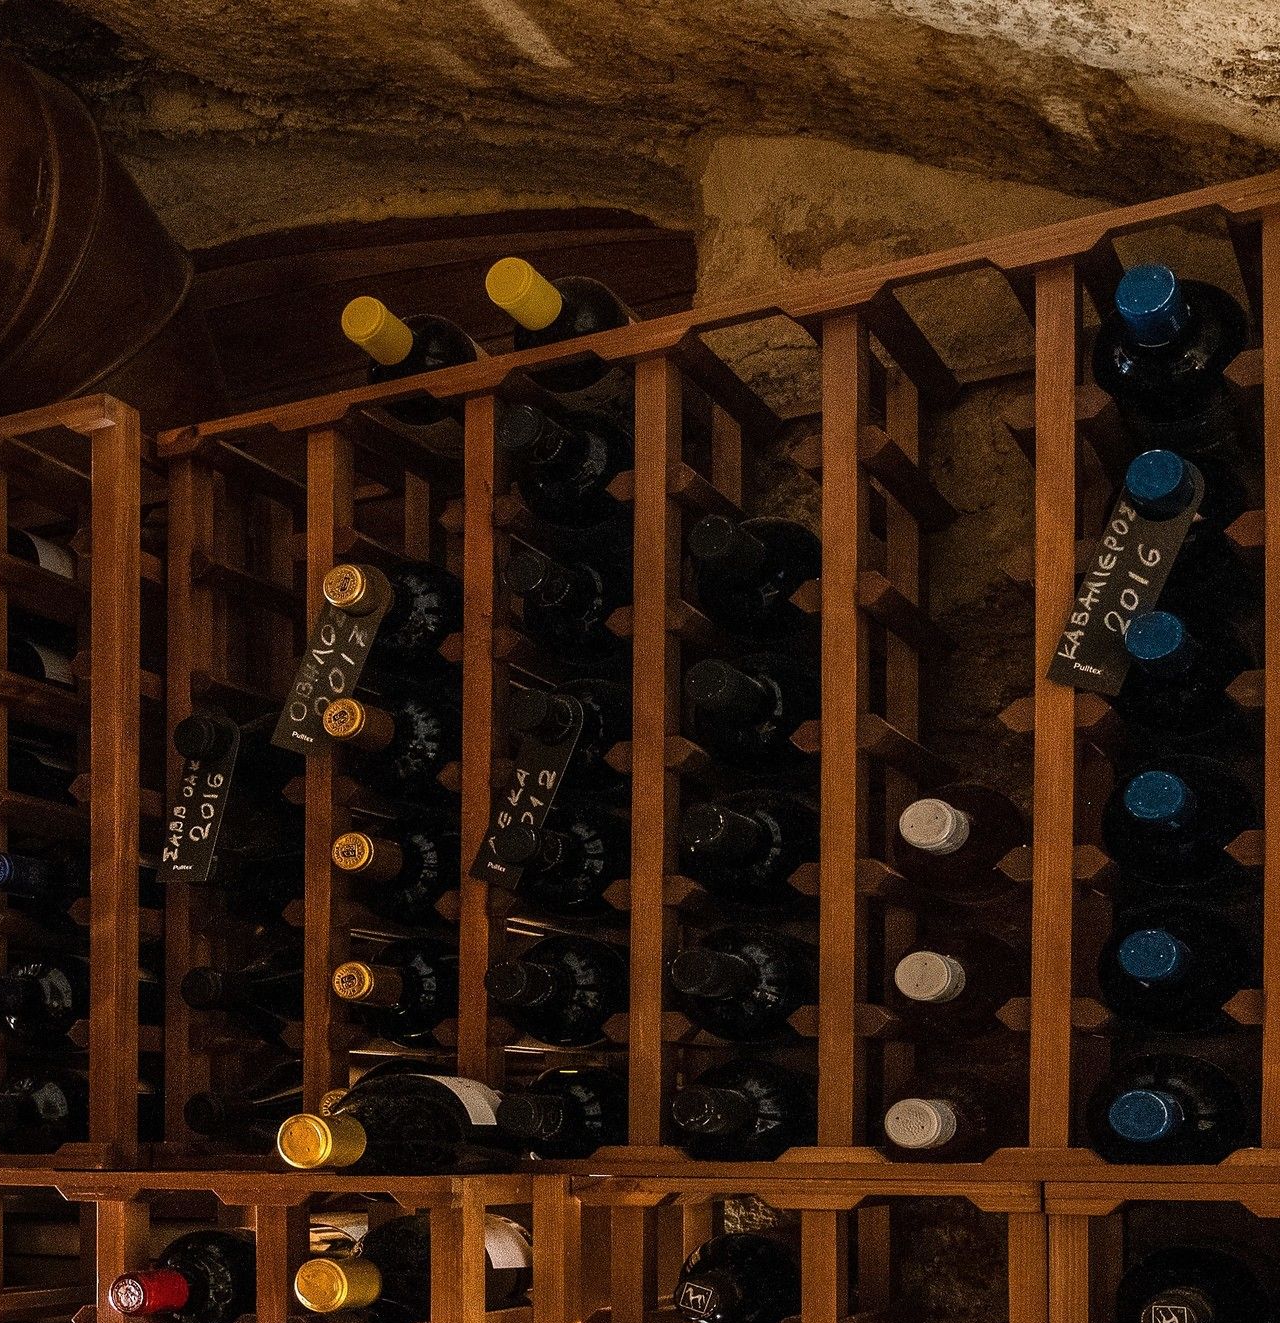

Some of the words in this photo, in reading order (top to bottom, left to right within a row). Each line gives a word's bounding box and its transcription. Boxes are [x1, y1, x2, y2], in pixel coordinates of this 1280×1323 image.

[1104, 544, 1161, 635] 2016
[1073, 662, 1102, 675] Pulltex
[292, 730, 314, 743] Pulltex
[189, 773, 224, 841] 2016
